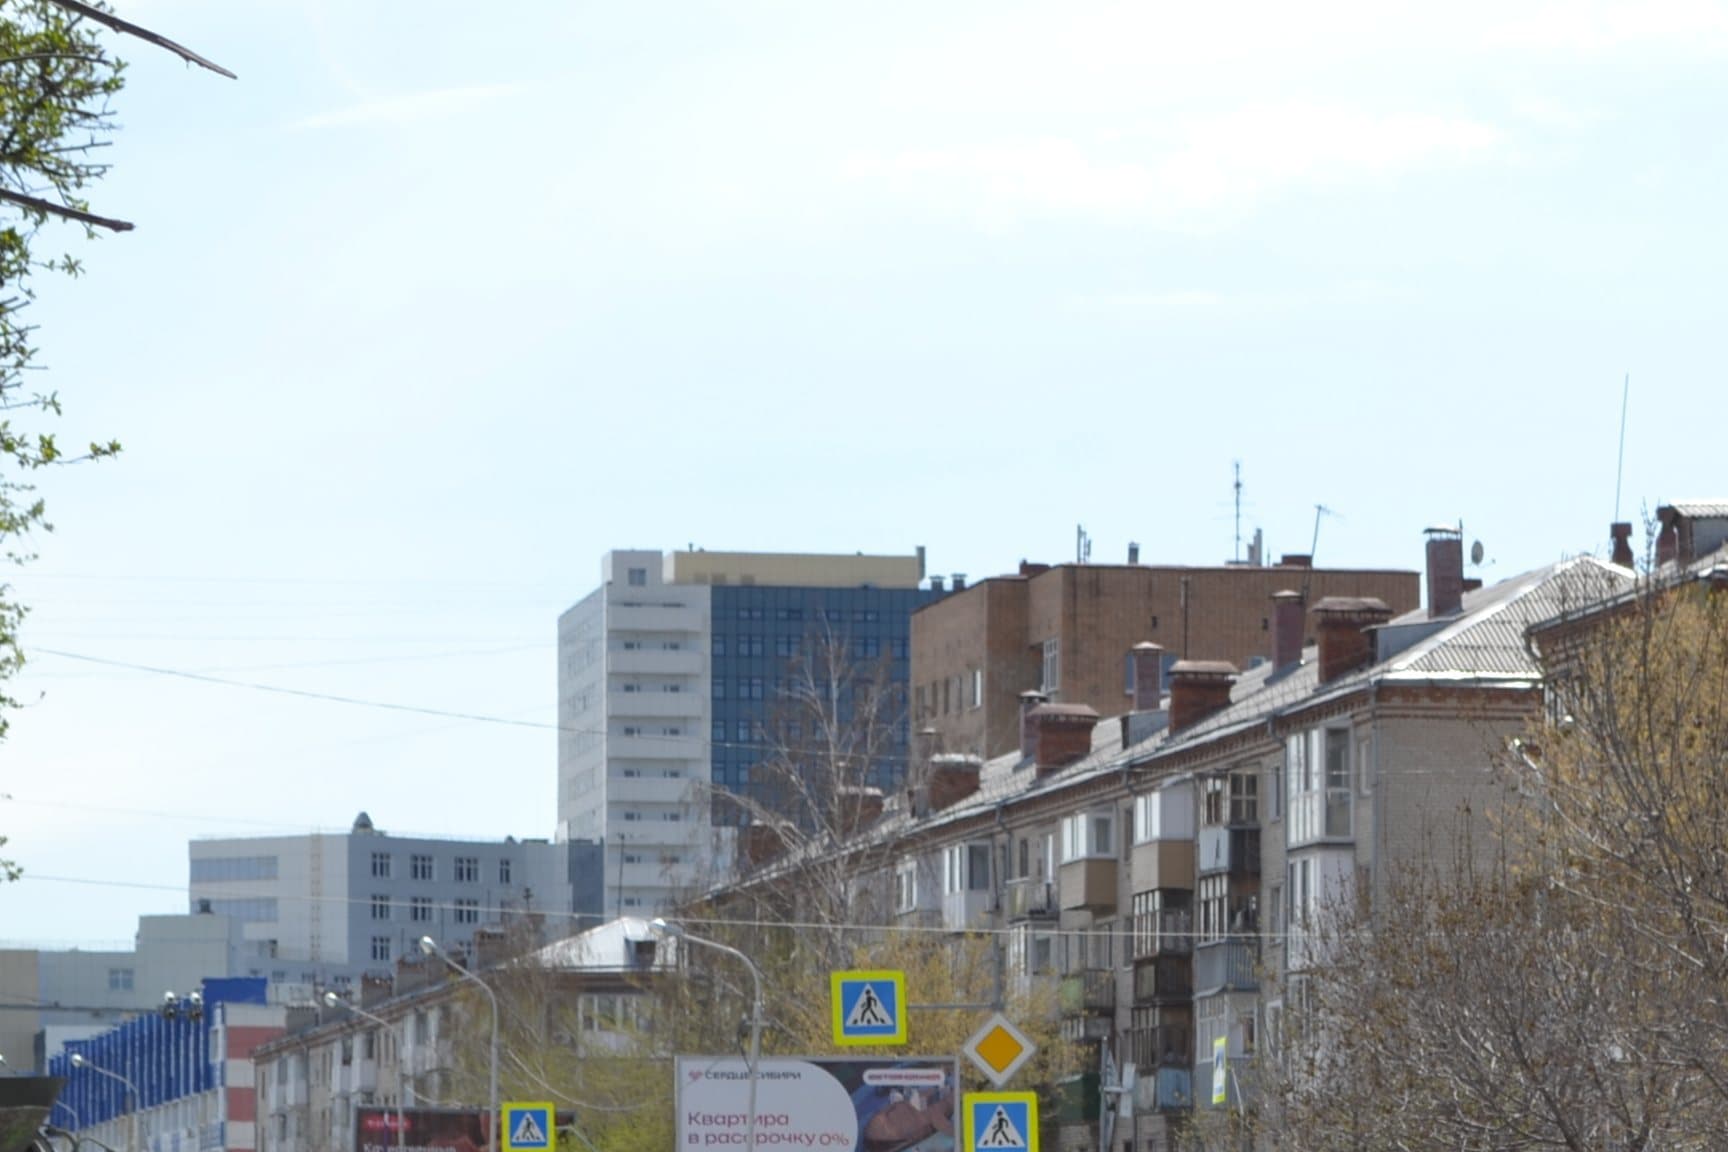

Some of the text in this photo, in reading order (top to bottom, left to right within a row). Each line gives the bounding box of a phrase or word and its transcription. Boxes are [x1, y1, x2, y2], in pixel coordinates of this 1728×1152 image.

[688, 1111, 789, 1128] Квартира
[688, 1132, 700, 1145] в
[819, 1132, 849, 1147] 0%
